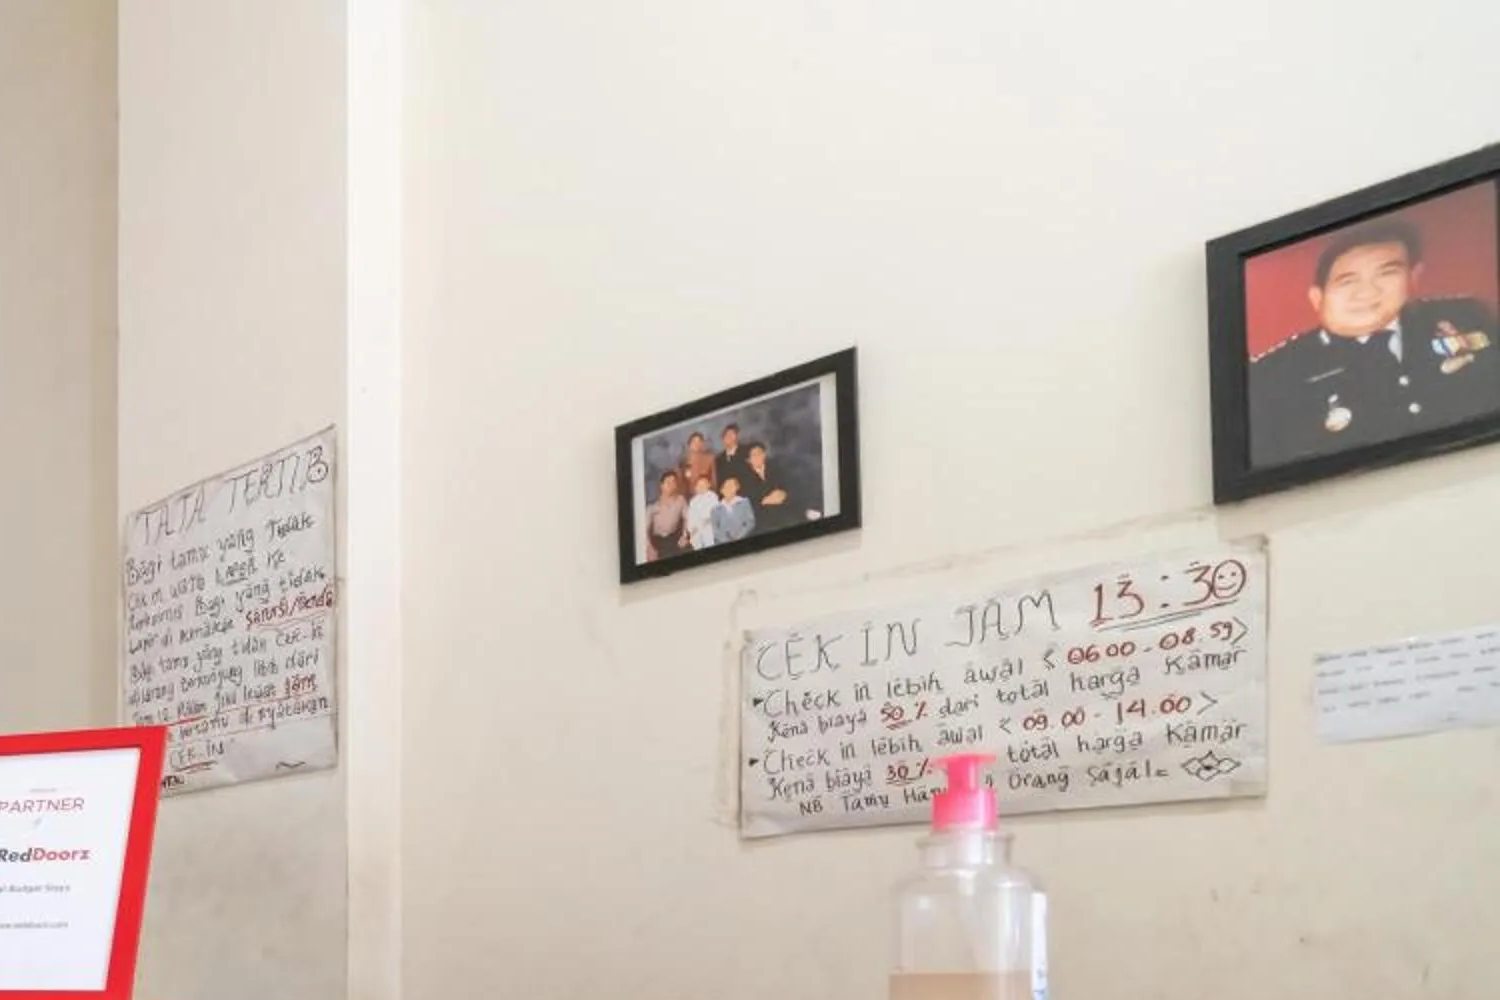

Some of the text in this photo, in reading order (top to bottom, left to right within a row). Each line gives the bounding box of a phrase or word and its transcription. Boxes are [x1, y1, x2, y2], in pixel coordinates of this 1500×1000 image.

[135, 445, 330, 545] TATA TERTIB
[860, 618, 922, 667] IN
[944, 590, 1060, 648] JAM
[763, 689, 841, 719] Check
[854, 681, 872, 702] in
[887, 671, 943, 698] lebih
[963, 657, 1024, 685] awal
[768, 719, 809, 744] Kena
[938, 693, 980, 720] dari
[996, 679, 1050, 705] total
[1070, 666, 1142, 700] harga
[763, 748, 831, 776] Check
[840, 741, 856, 761] in
[871, 734, 923, 757] lebih
[937, 723, 983, 746] awal
[769, 777, 816, 802] Kena
[826, 766, 873, 797] biaya
[1007, 738, 1060, 765] total
[1077, 730, 1143, 754] harga
